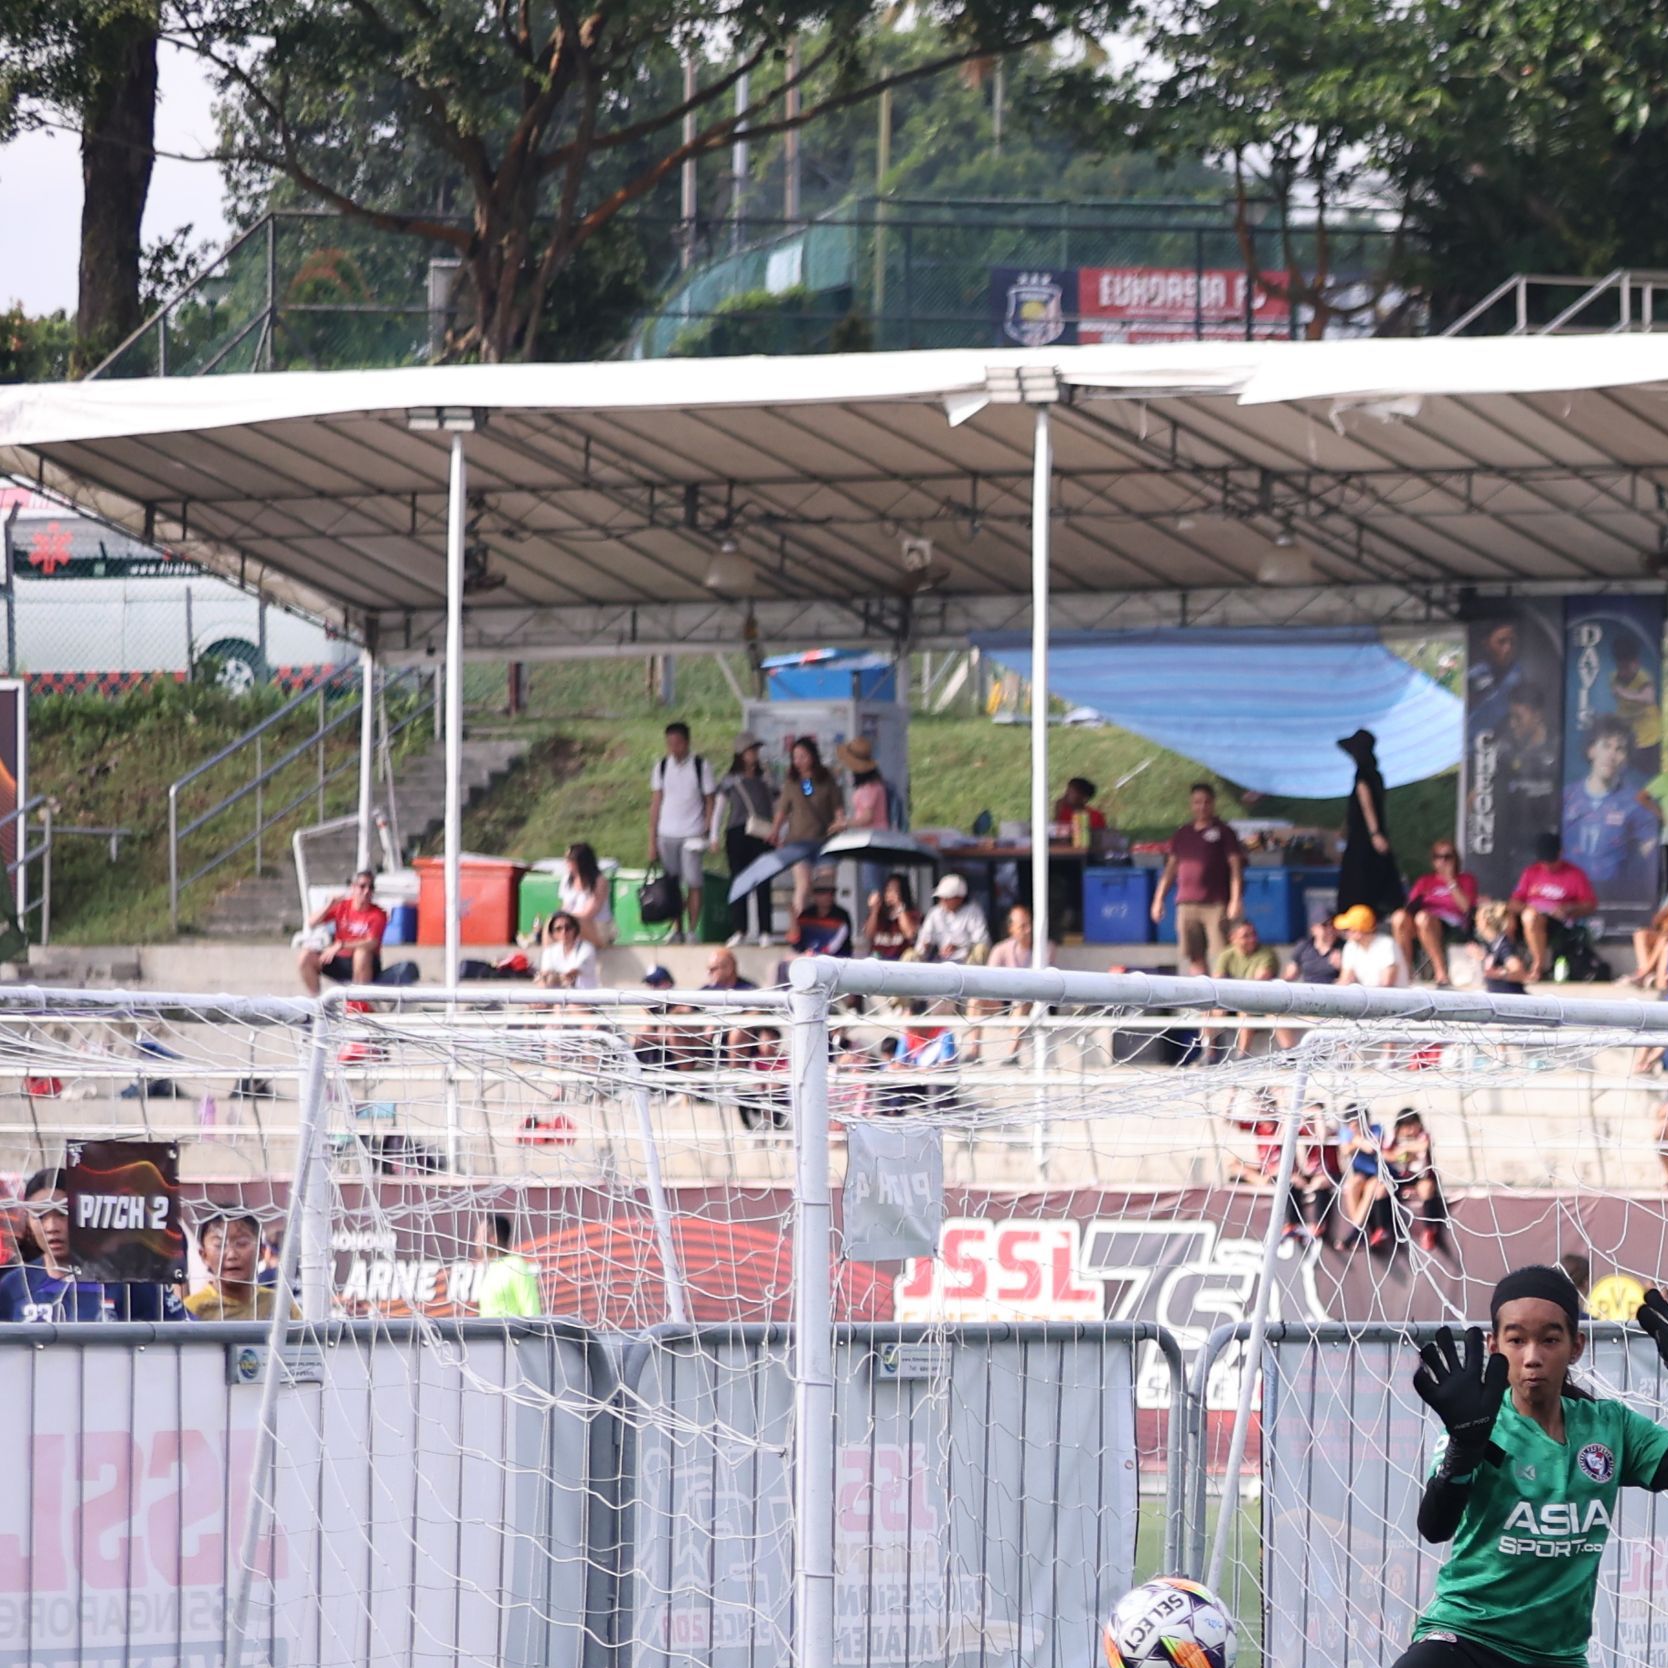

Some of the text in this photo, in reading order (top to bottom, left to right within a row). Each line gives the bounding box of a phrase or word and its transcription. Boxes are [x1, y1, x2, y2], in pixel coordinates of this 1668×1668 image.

[77, 1195, 169, 1231] PITCH 2
[341, 1258, 438, 1301] ARNE
[902, 1229, 1097, 1303] JSSL
[1503, 1499, 1611, 1536] ASIA
[1123, 1592, 1185, 1655] SELECT
